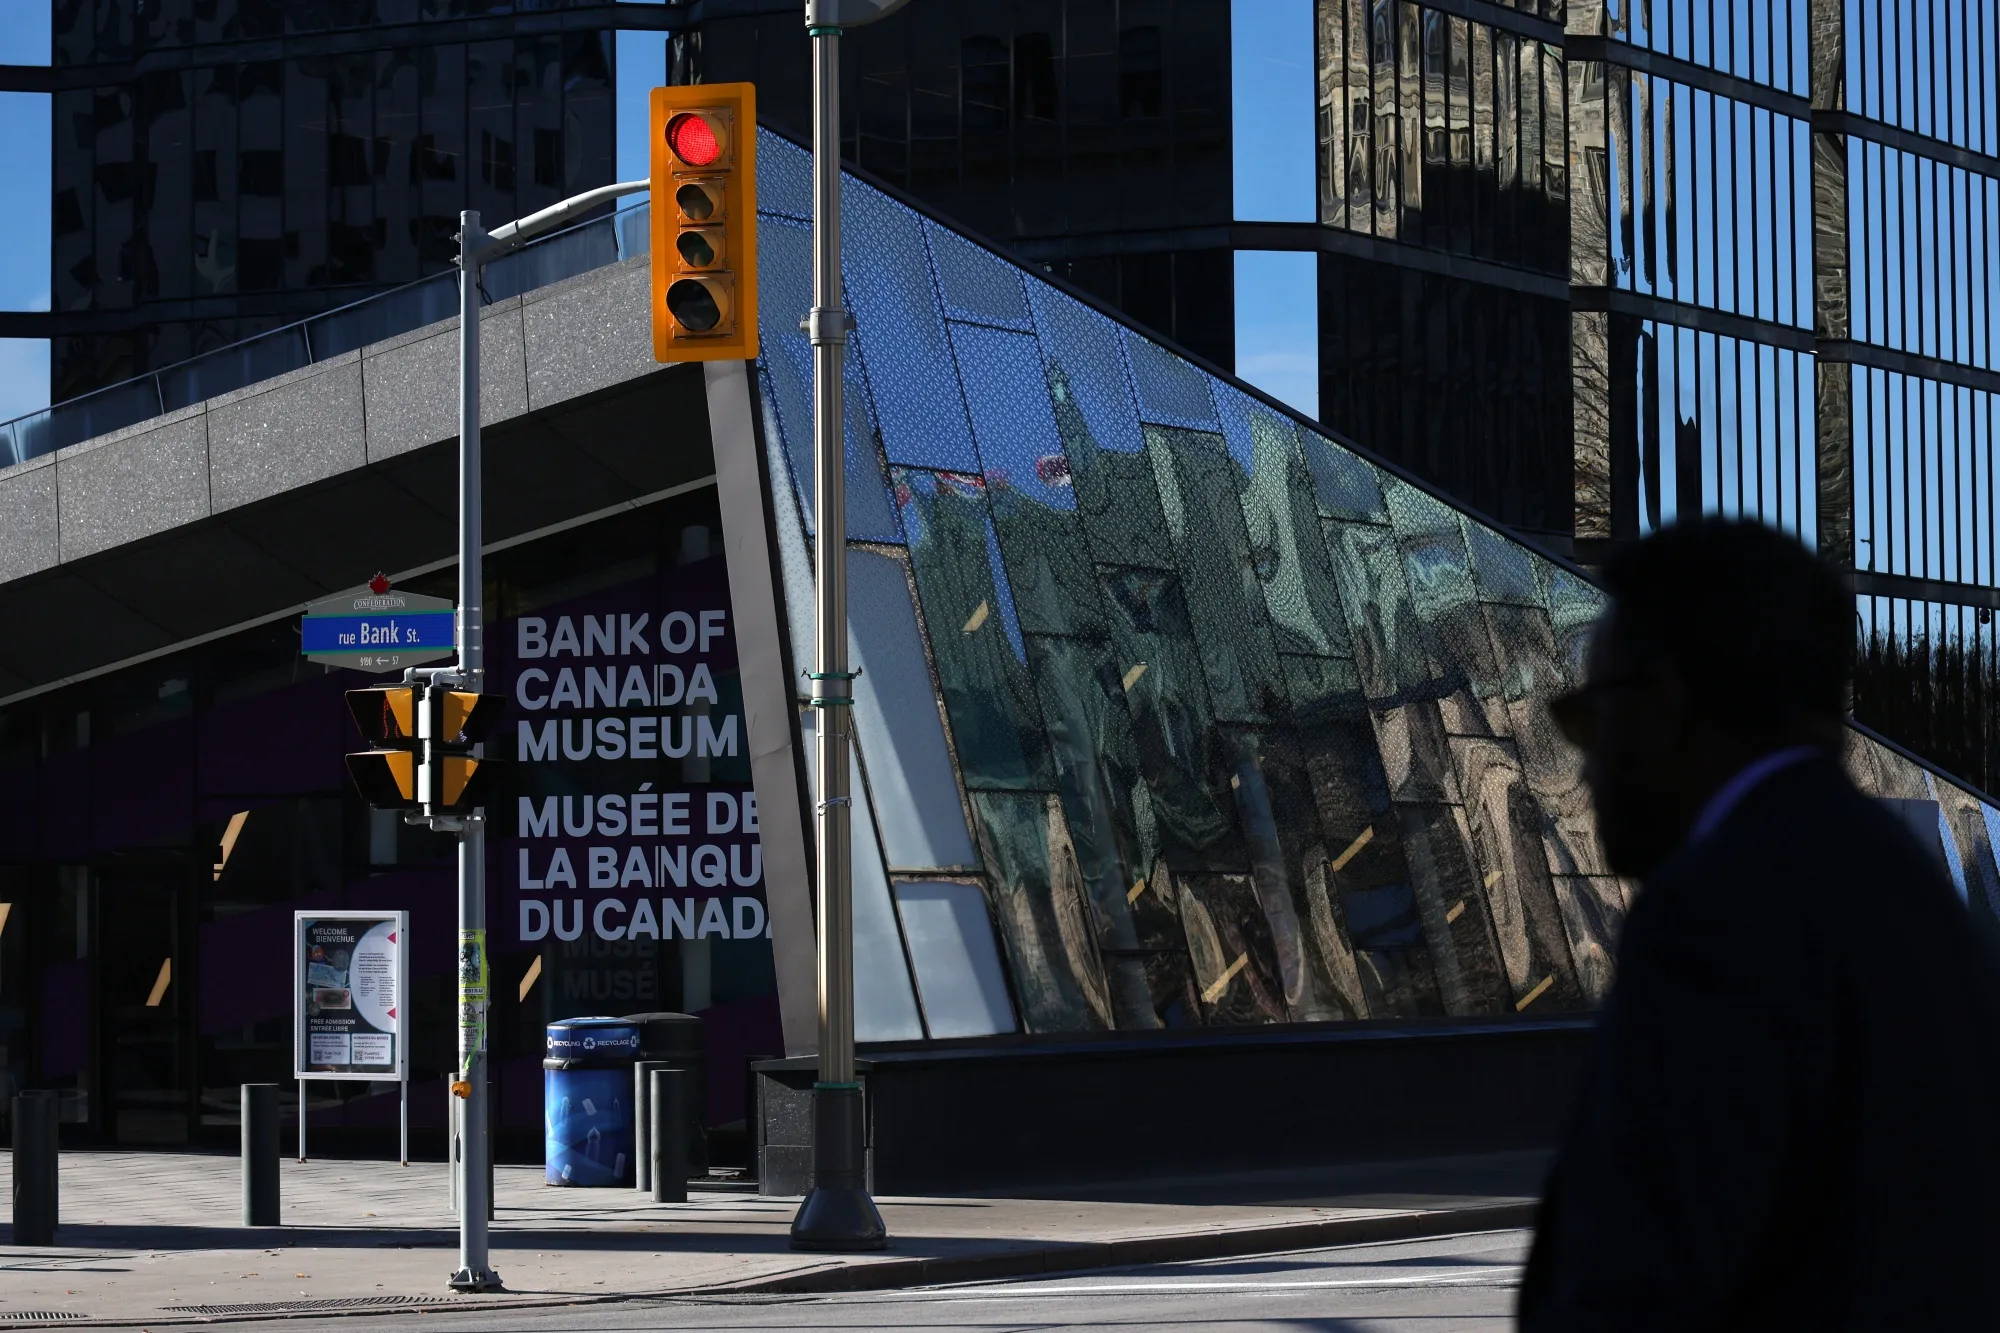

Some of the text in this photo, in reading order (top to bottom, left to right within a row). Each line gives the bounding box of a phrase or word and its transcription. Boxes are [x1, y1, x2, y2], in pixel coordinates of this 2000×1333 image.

[354, 598, 406, 610] CONFEDERATION
[339, 620, 420, 645] rue Bank St.
[517, 610, 726, 659] BANK OF
[516, 662, 718, 710] CANADA
[517, 714, 738, 762] MUSEUM
[518, 782, 760, 838] MUSÉE DE
[519, 843, 763, 890] LA BANQU
[316, 935, 355, 943] BIENVENUE
[519, 896, 773, 942] DU CANAD
